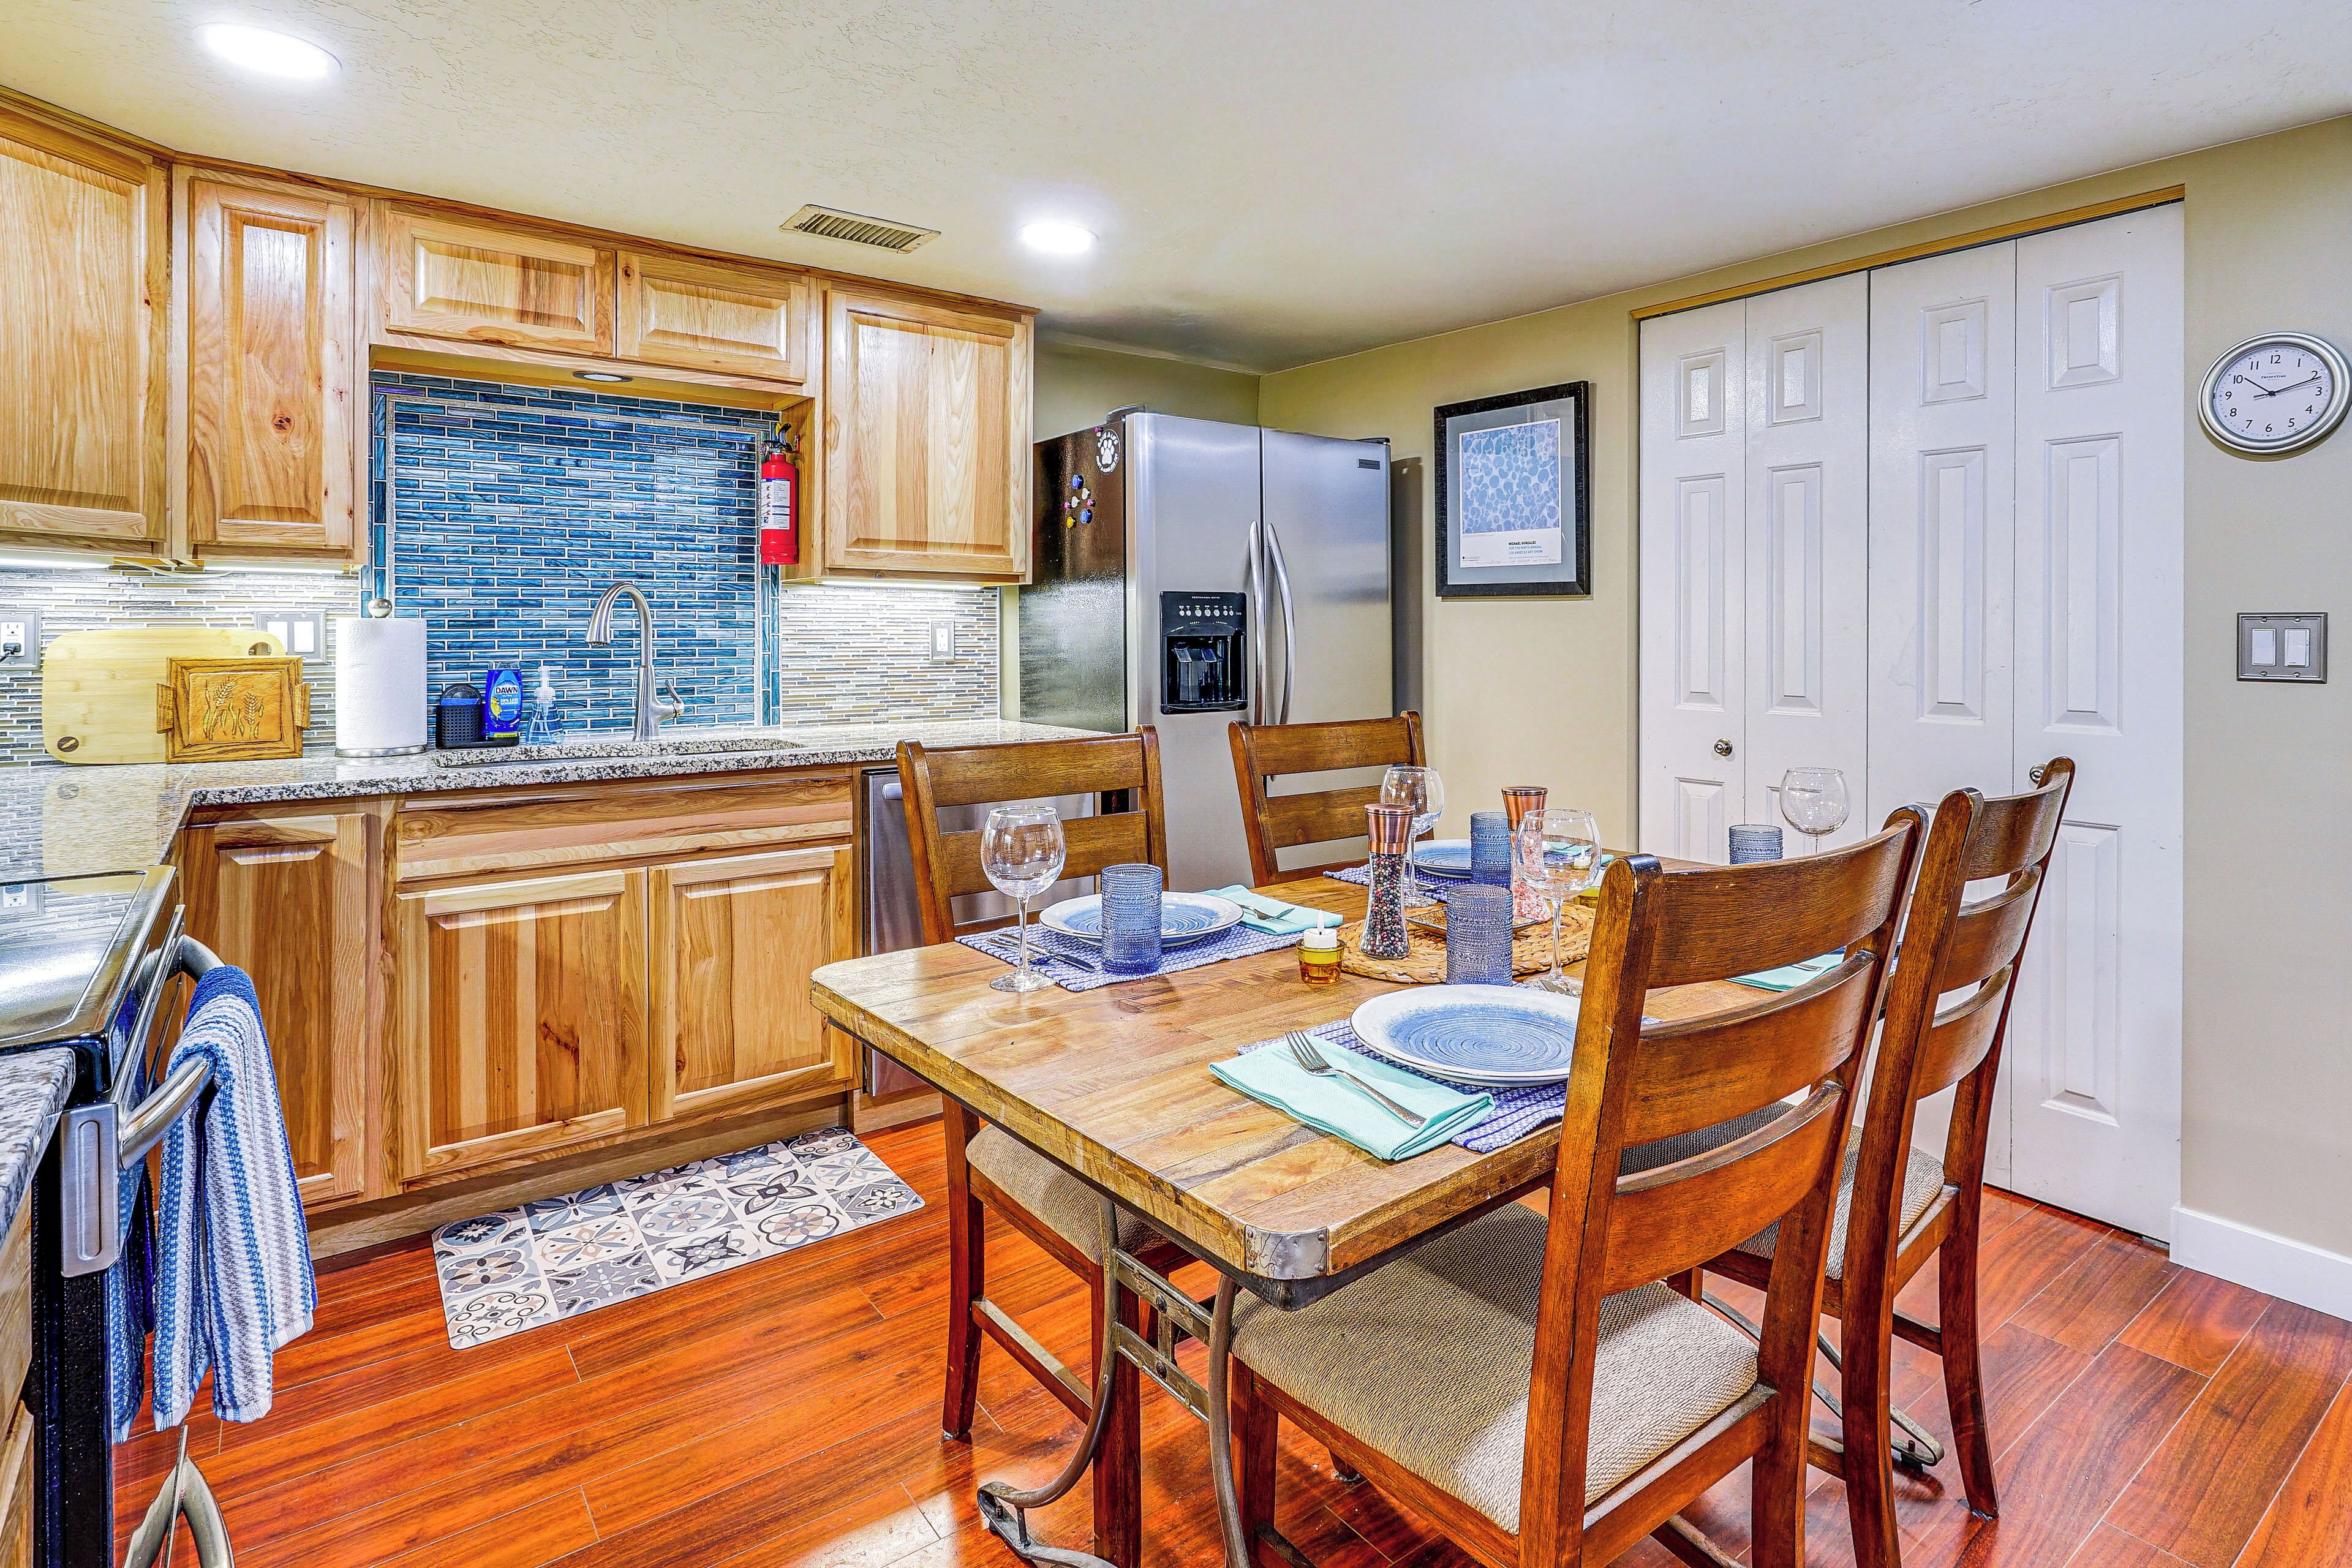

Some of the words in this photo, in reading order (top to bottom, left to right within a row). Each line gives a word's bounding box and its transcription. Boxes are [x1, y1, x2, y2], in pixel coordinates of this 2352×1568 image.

[2271, 355, 2281, 364] 12
[2297, 358, 2301, 368] 1
[2250, 361, 2259, 370] 11
[2233, 374, 2243, 384] 10
[2311, 371, 2319, 380] 2
[2225, 391, 2232, 400] 9
[2315, 386, 2322, 396] 3
[2230, 408, 2237, 417] 8
[2305, 405, 2313, 414] 4
[2245, 420, 2253, 429] 7
[2288, 418, 2295, 427] 5
[2265, 423, 2272, 432] 6
